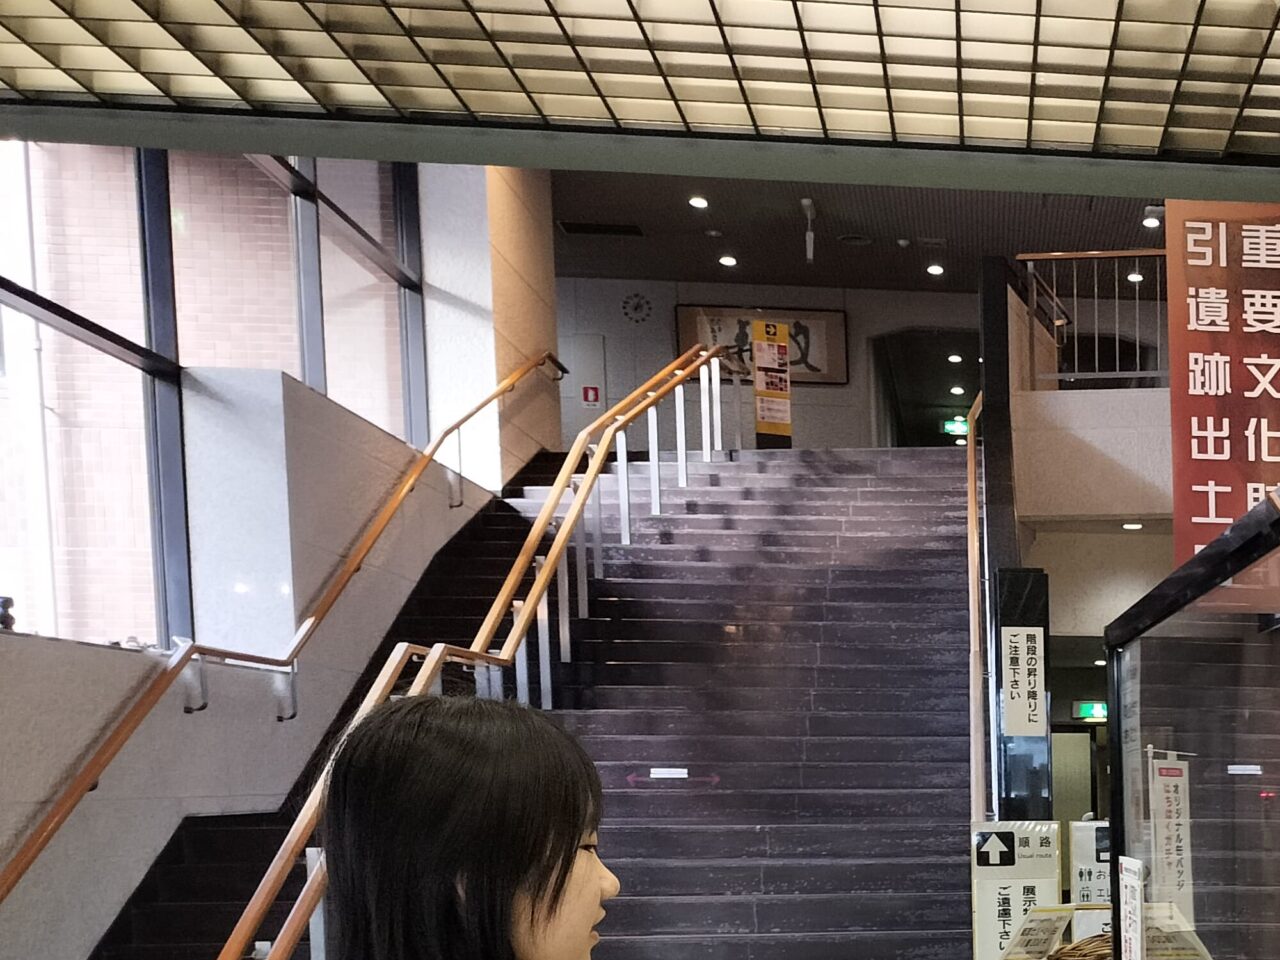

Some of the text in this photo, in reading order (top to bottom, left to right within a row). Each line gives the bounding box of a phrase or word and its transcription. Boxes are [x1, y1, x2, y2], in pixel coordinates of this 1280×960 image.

[1185, 221, 1234, 556] 引遺跡出土
[1009, 633, 1021, 700] ご注意下さい
[1026, 633, 1038, 723] 階段の昇り降りに
[1018, 836, 1051, 848] 順路
